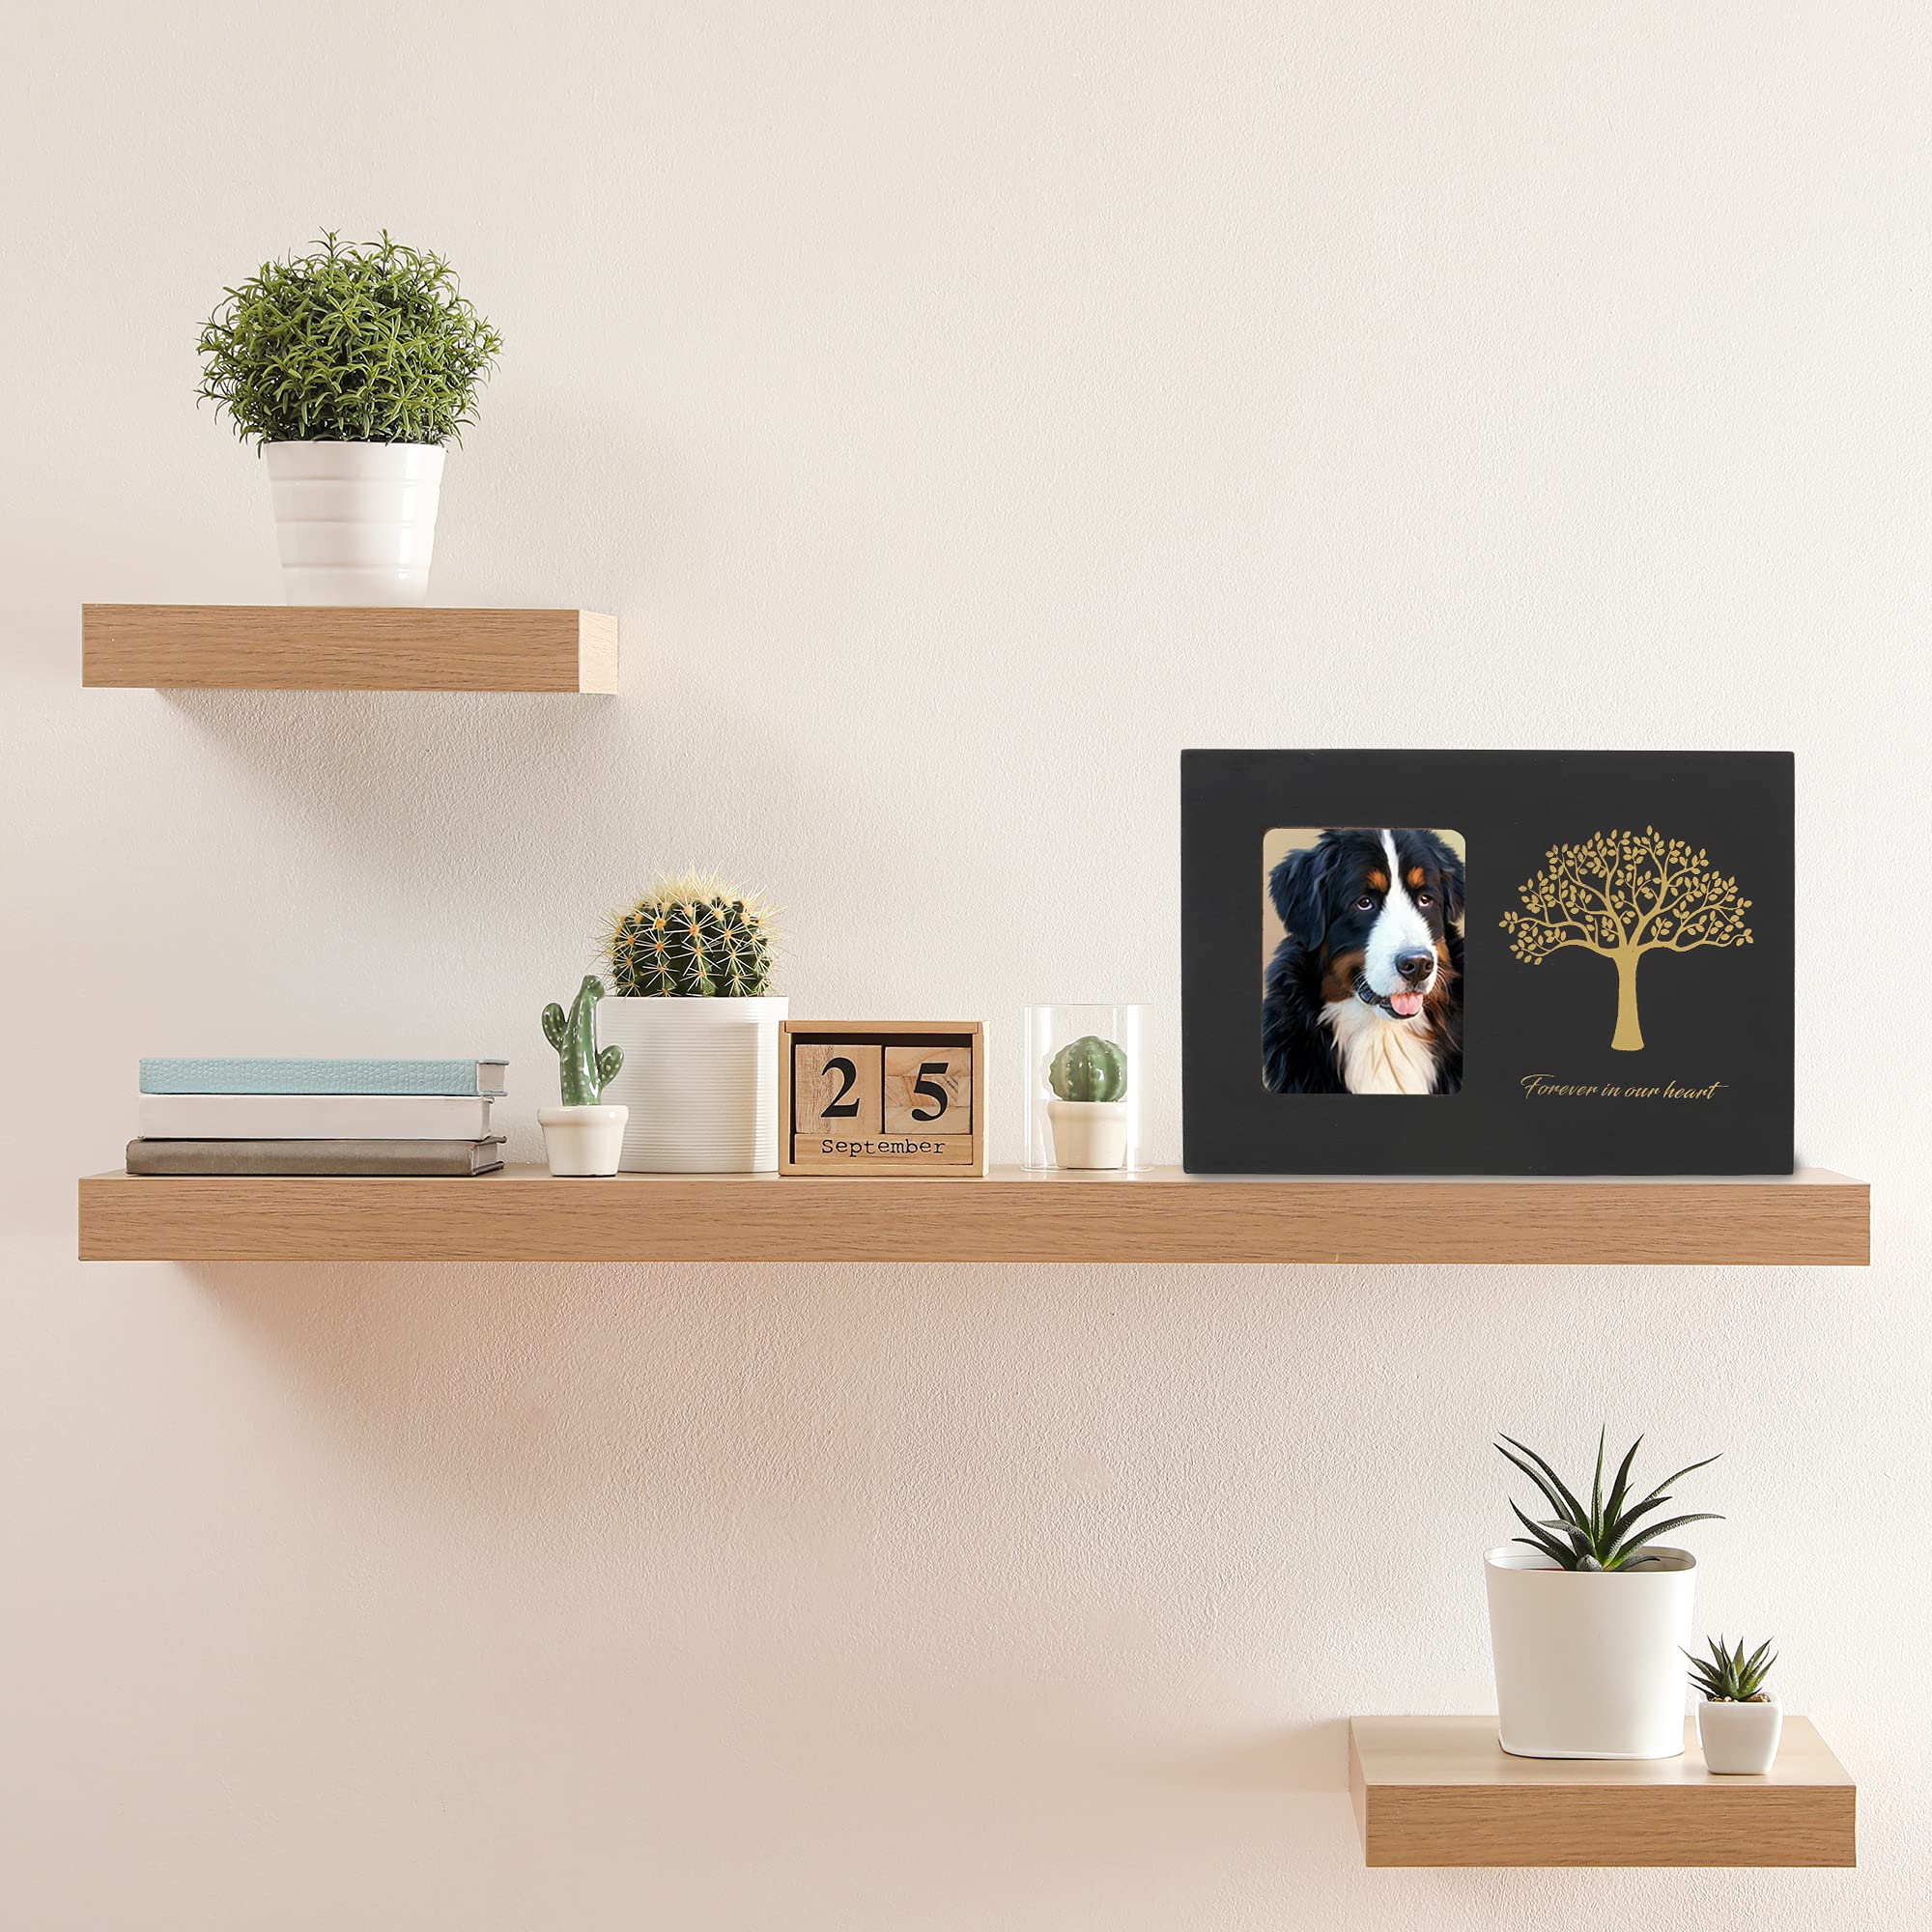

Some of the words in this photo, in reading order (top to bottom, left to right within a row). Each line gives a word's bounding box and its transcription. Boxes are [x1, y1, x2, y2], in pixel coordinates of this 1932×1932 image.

[1520, 1073, 1599, 1100] Forever
[1600, 1083, 1623, 1097] in
[1624, 1086, 1662, 1098] our
[1662, 1079, 1730, 1100] heart
[821, 1139, 946, 1158] September
